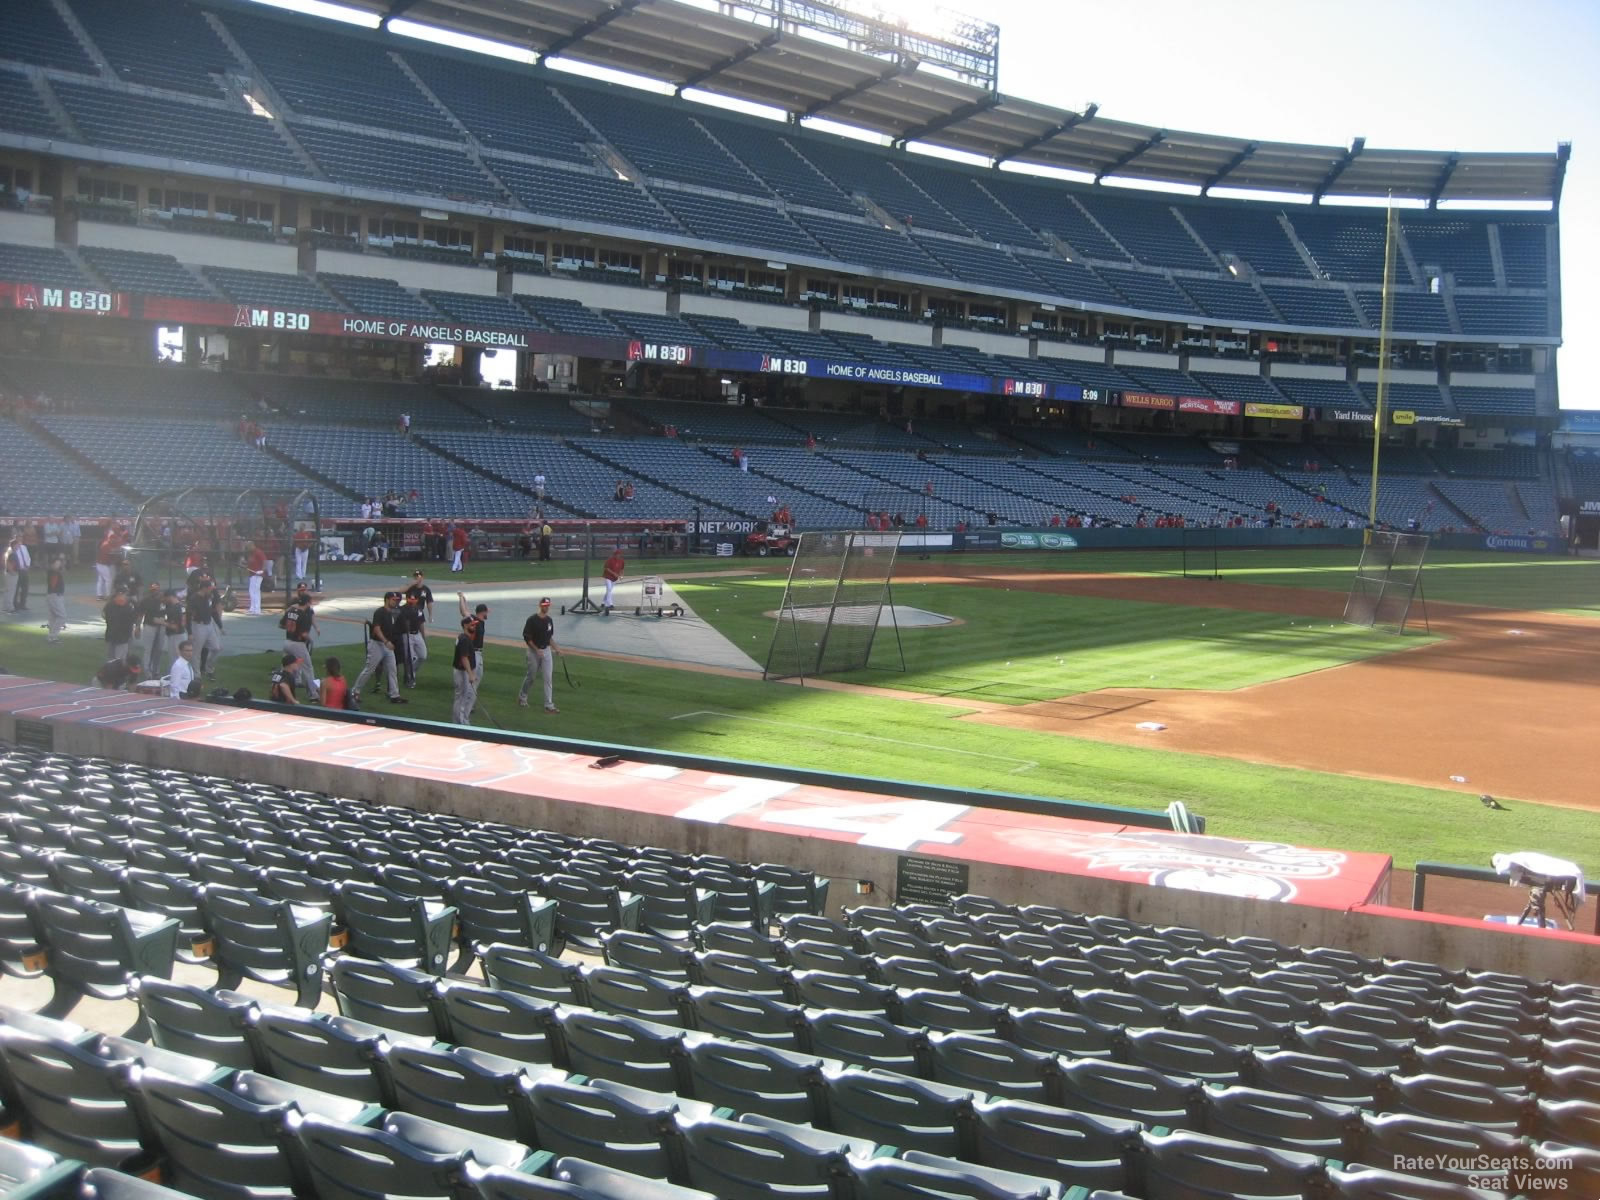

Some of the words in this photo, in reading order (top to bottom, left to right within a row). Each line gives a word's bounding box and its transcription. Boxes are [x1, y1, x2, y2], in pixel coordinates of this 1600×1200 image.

[69, 290, 111, 311] 830
[273, 311, 310, 330] 830
[344, 319, 385, 335] HOME
[389, 322, 407, 336] OF
[410, 325, 462, 341] ANGELS
[465, 330, 528, 347] BASEBALL
[660, 345, 686, 361] 830
[784, 360, 807, 374] 830
[827, 364, 853, 377] HOME
[855, 367, 867, 378] OF
[868, 369, 901, 381] ANGELS
[902, 372, 942, 385] BASEBALL
[1025, 383, 1042, 395] 830
[1083, 389, 1098, 400] 5:09
[1125, 395, 1150, 404] WELLS
[1151, 397, 1174, 407] FARGO
[1334, 410, 1350, 420] Yard
[1351, 411, 1373, 421] House
[1486, 536, 1528, 549] Corona
